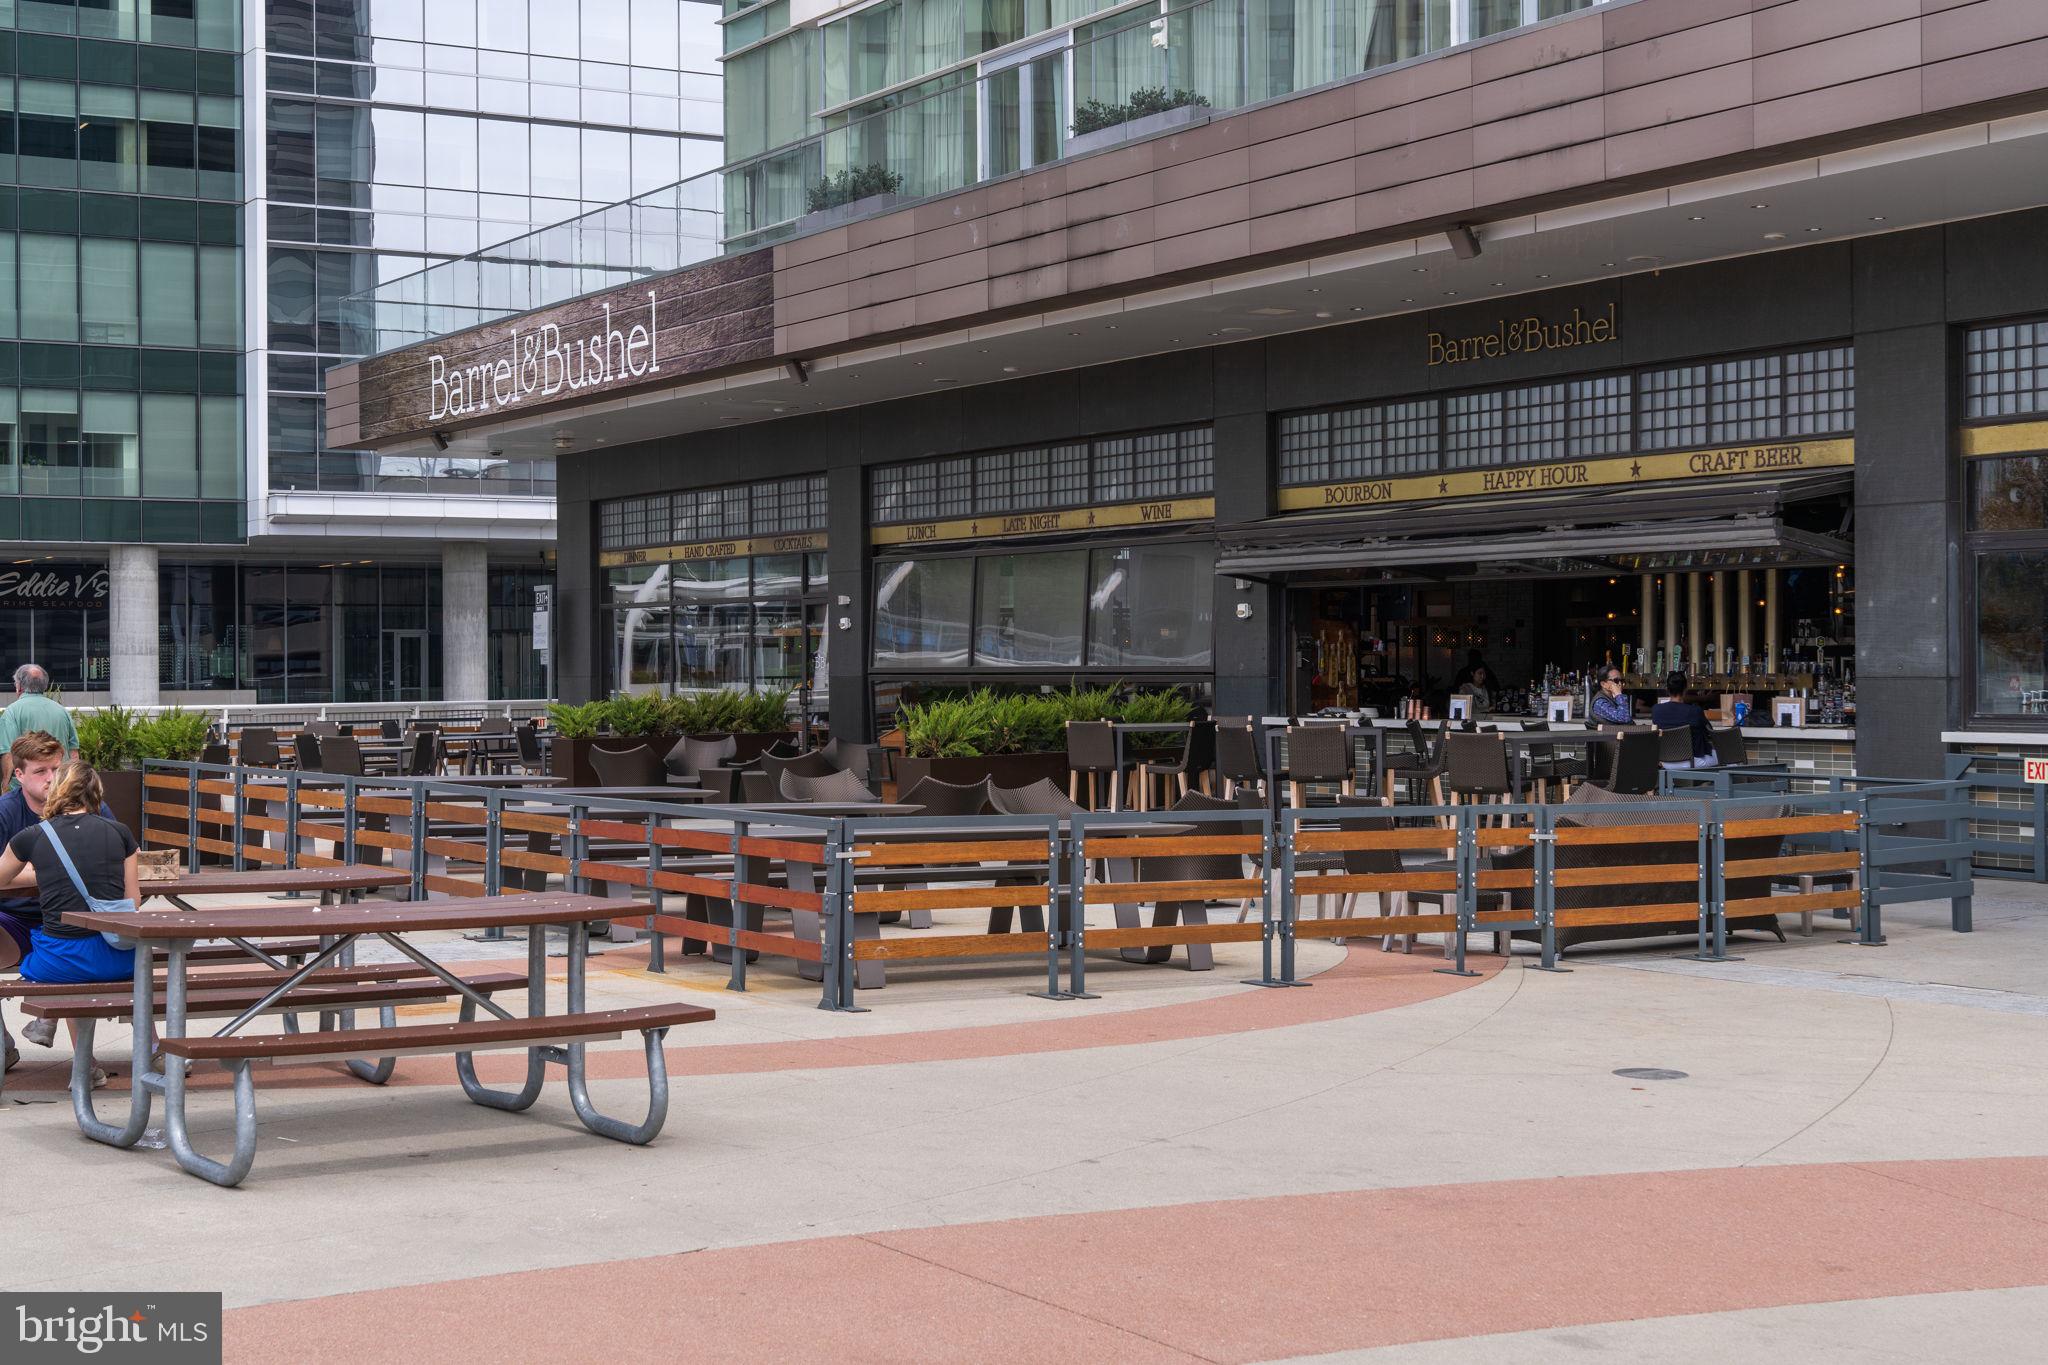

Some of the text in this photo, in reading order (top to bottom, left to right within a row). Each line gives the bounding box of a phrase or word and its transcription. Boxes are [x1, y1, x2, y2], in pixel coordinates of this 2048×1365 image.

[1427, 302, 1617, 366] Barrel&Bushel
[428, 290, 660, 421] Barrel&Bushel
[1324, 446, 1804, 505] BOURBON HAPPY HOUR CRAFT BEER
[906, 503, 1172, 541] LUNCH LATE NIGHT WINE
[623, 536, 814, 563] DINNER HAND CRAFTED COCKTAILS
[0, 571, 71, 598] Eddie
[3, 600, 35, 608] RIME
